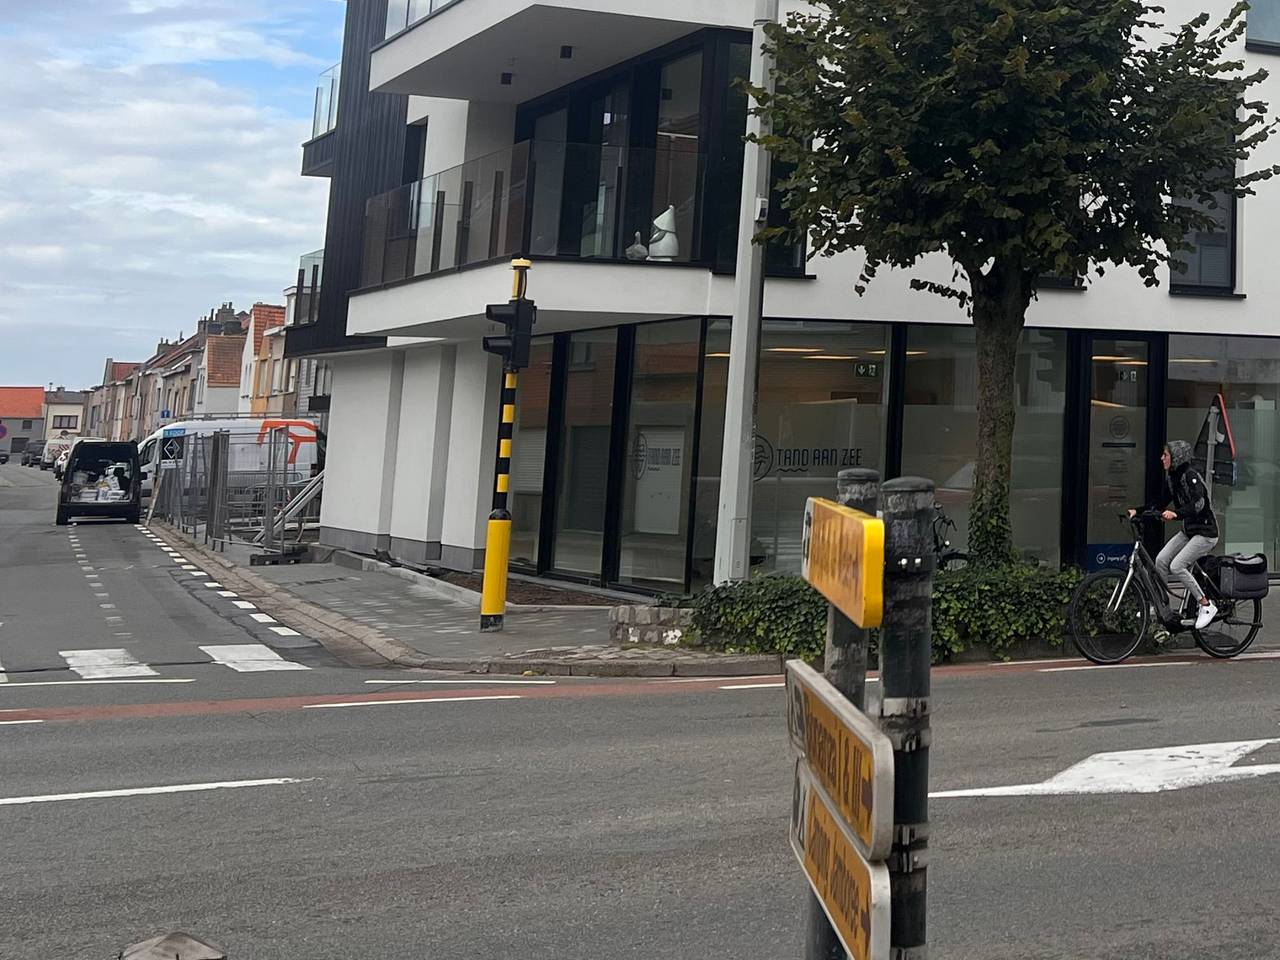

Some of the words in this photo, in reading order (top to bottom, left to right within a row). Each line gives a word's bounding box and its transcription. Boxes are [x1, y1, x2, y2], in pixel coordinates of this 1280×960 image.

[776, 448, 809, 466] TAND
[813, 448, 838, 466] AAN
[841, 448, 862, 466] ZEE
